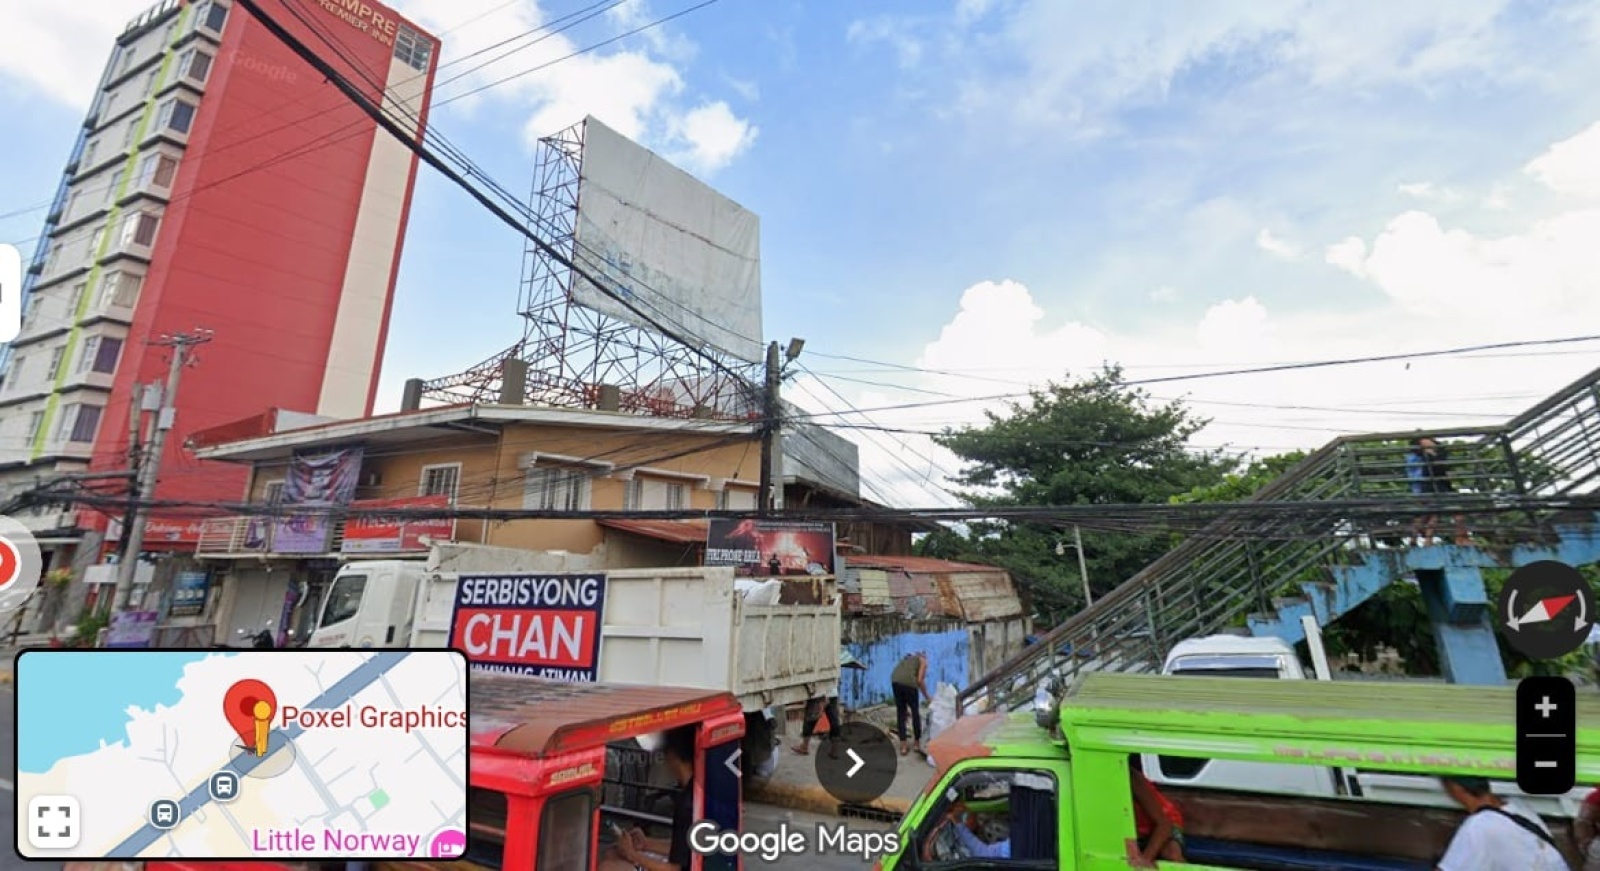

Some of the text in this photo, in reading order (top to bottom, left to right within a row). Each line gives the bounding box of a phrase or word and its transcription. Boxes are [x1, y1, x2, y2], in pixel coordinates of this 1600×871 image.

[333, 0, 396, 35] MPRE
[371, 29, 393, 46] INN
[461, 578, 598, 605] SERBISYONG
[464, 613, 583, 660] CHAN
